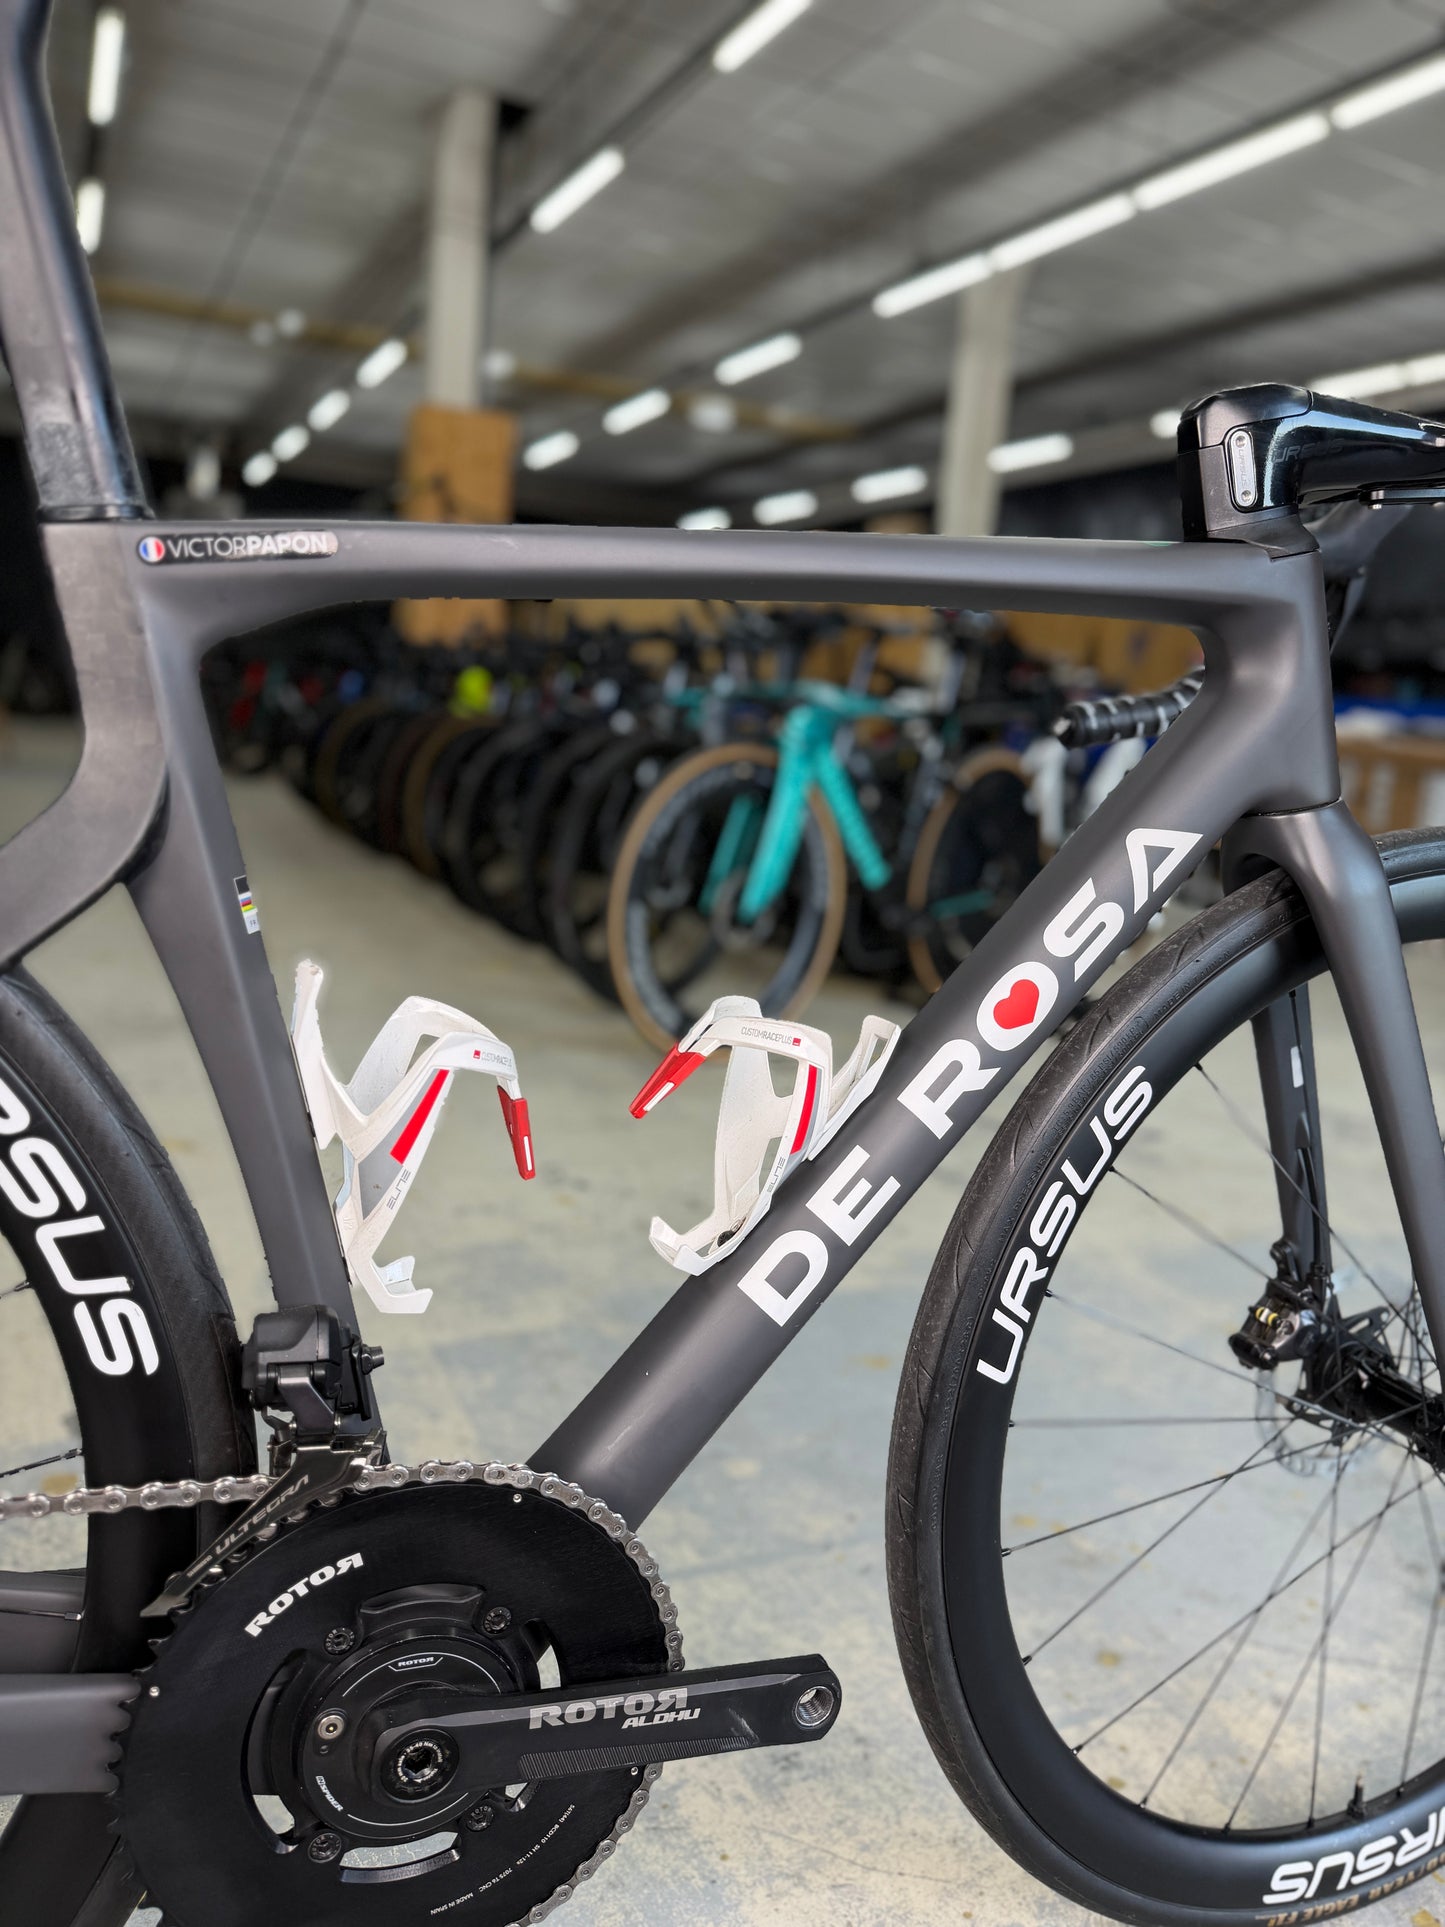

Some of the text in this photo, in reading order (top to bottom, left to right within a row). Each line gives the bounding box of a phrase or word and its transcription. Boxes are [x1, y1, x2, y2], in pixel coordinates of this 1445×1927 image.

[740, 1026, 793, 1044] CUSTOMRACEPLUS
[737, 828, 1203, 1327] DE ROSA
[976, 1066, 1153, 1384] URSUS
[215, 1474, 309, 1555] ULTEGRA
[244, 1552, 364, 1637] ROTOR
[397, 1656, 435, 1667] ROTOR
[528, 1688, 688, 1729] ROTOR
[621, 1708, 701, 1729] ALDHU
[478, 1881, 492, 1892] CNC
[455, 1892, 474, 1905] MADE
[430, 1904, 448, 1915] SPAIN
